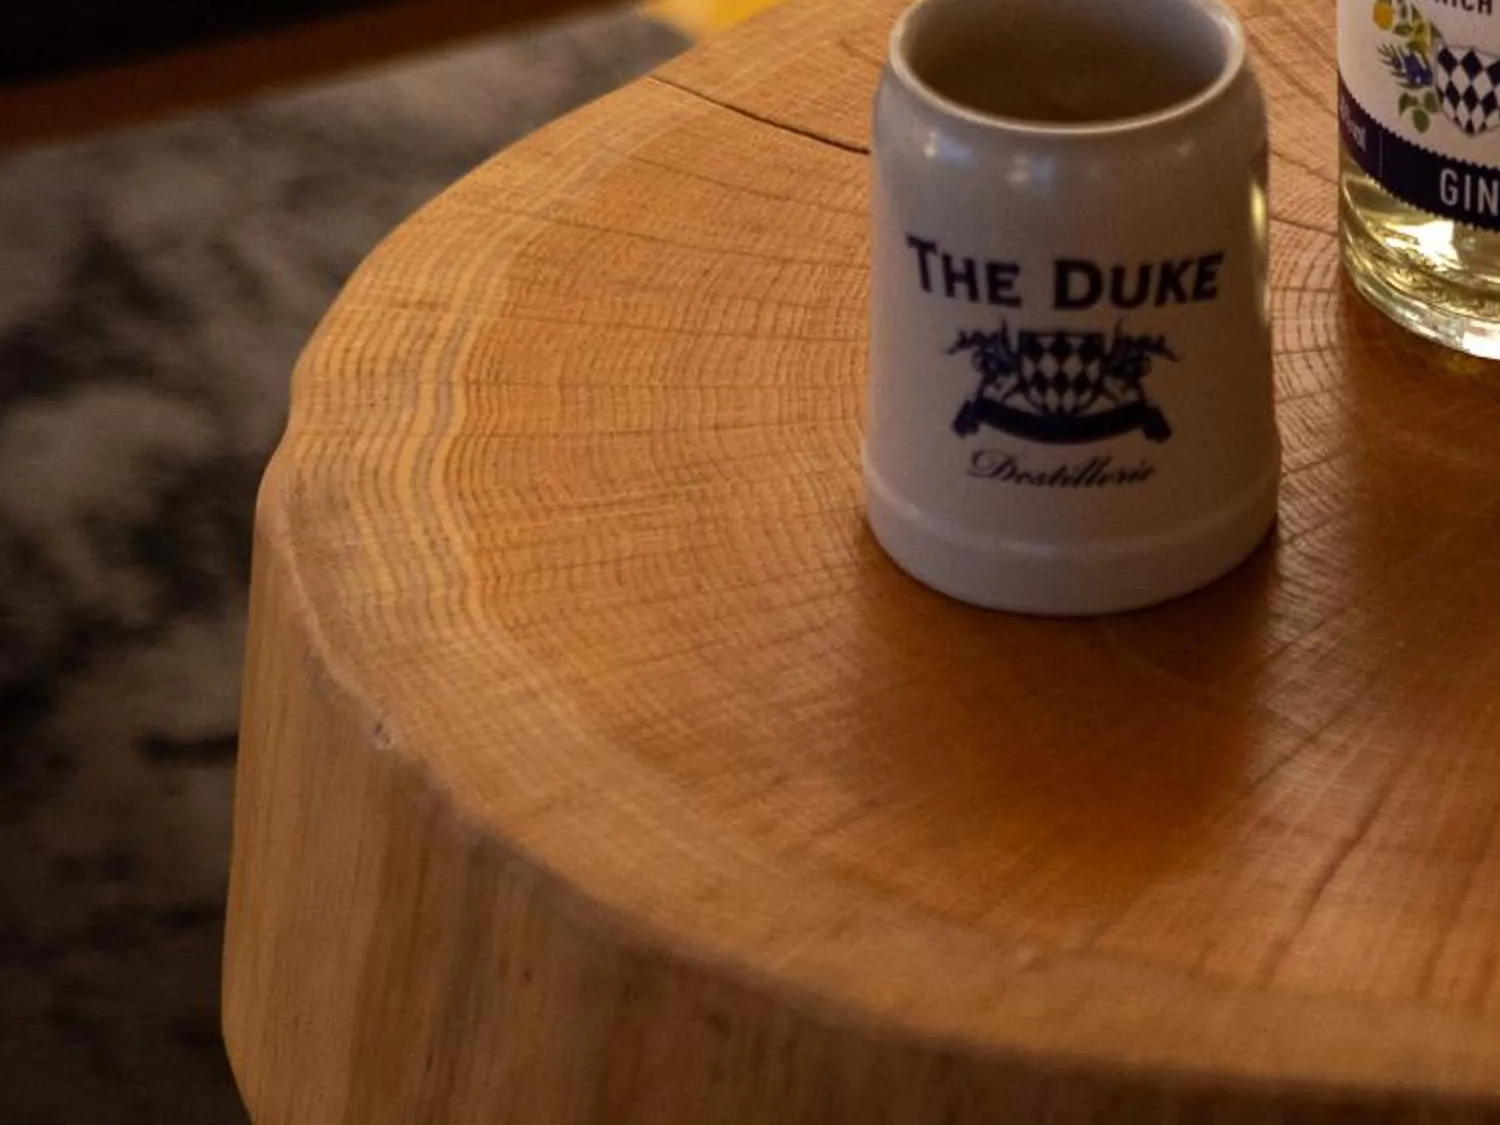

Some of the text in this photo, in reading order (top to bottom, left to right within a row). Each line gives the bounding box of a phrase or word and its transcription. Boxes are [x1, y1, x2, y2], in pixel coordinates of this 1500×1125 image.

[1439, 168, 1500, 218] GIN
[905, 233, 1225, 311] THE DUKE
